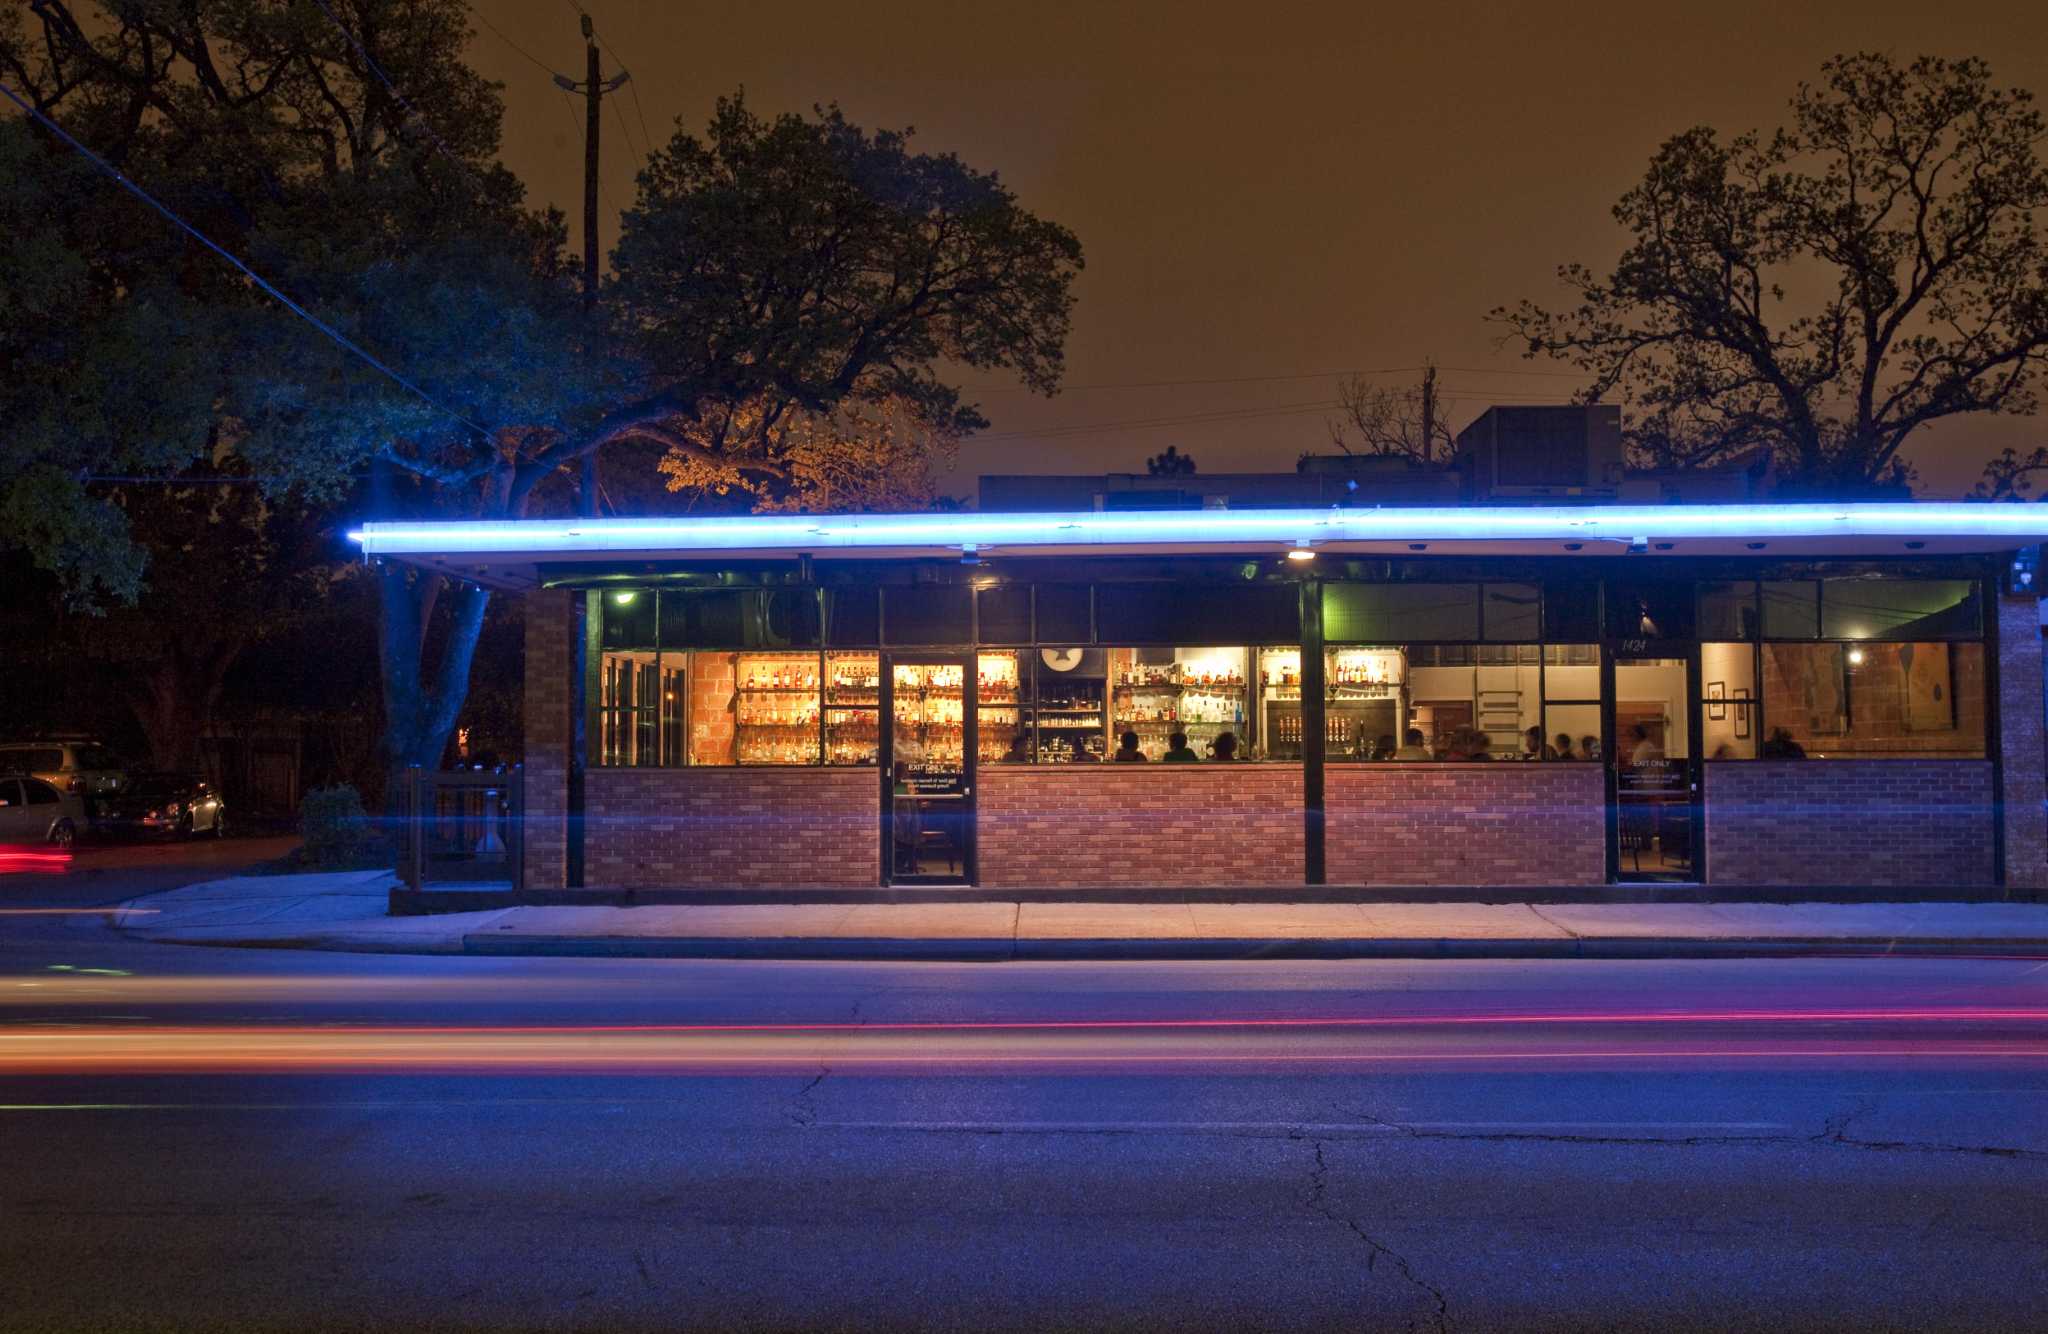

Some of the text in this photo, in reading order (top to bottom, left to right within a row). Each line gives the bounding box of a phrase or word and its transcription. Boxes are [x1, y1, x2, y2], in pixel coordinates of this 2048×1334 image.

[1622, 639, 1647, 651] 1424
[908, 763, 945, 771] EXIT ONLY
